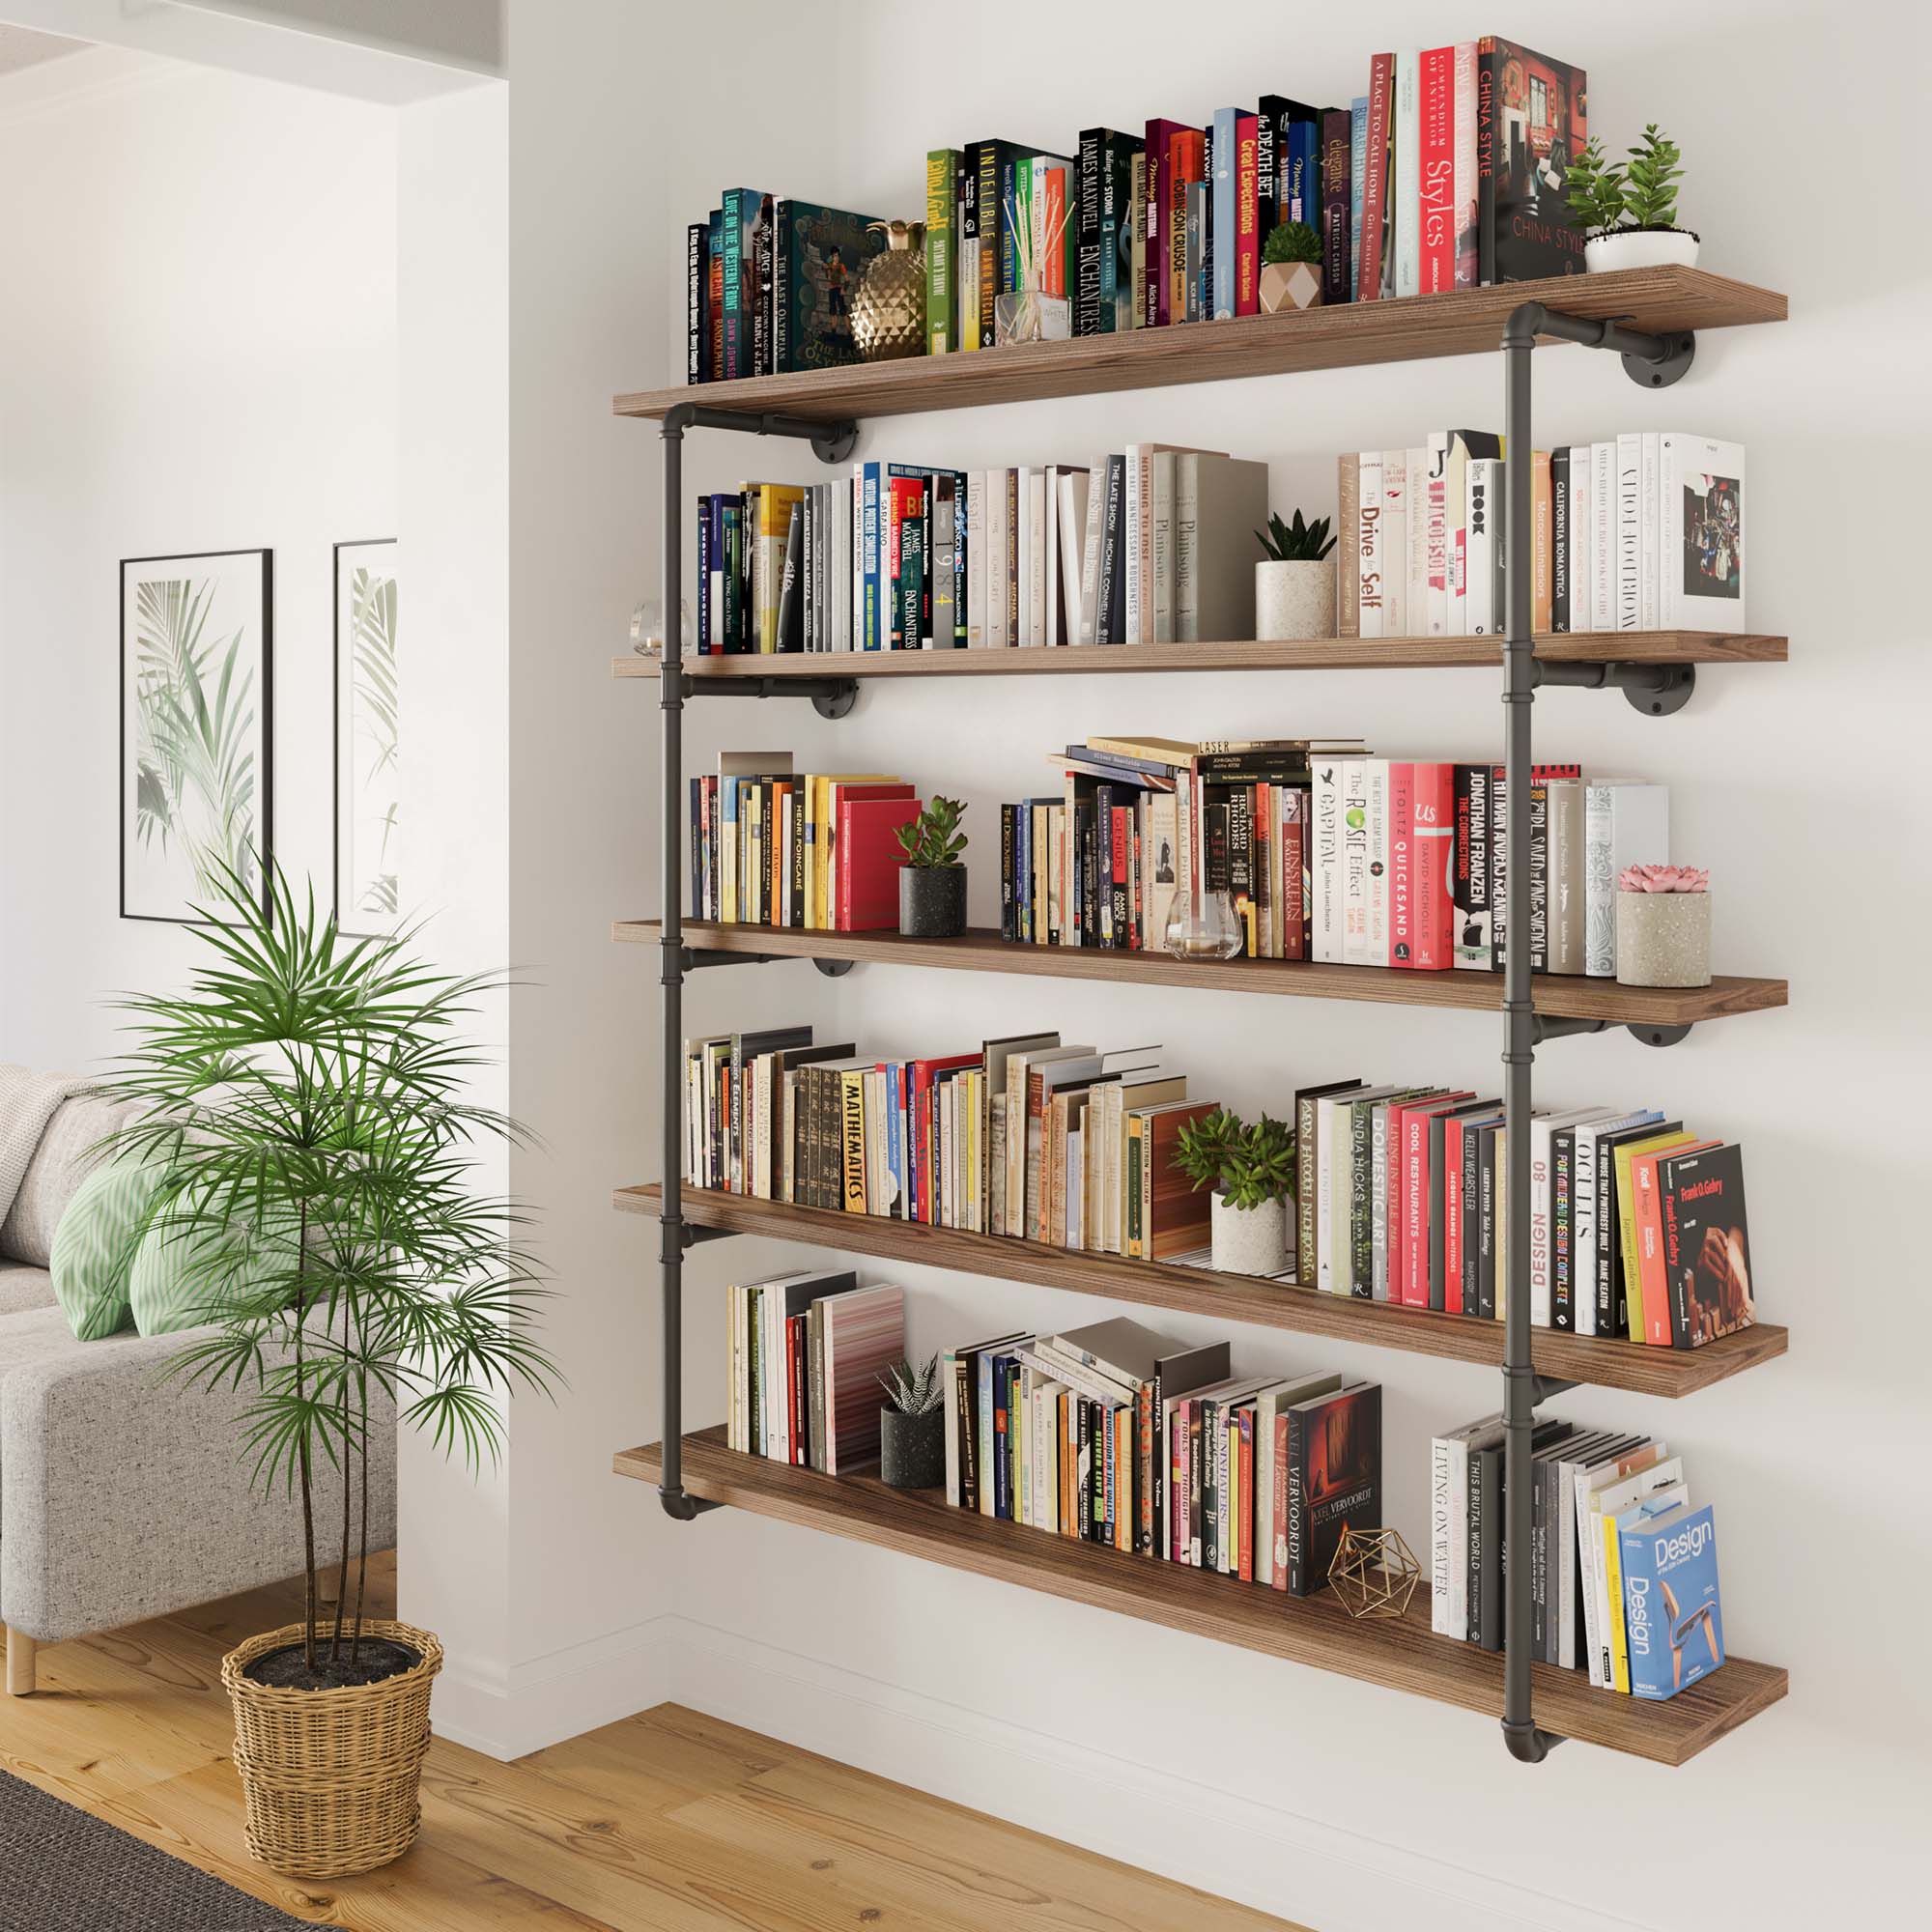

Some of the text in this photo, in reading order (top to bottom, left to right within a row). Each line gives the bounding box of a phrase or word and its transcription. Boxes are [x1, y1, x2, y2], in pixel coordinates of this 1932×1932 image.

[1373, 73, 1383, 110] PLACE
[1370, 135, 1380, 164] CALL
[1372, 116, 1381, 131] TO
[1478, 71, 1492, 178] CHINA STYLE
[1080, 138, 1097, 173] JAMES
[1103, 150, 1113, 214] Riding the STORM
[1258, 115, 1272, 198] the DEATH BET
[1321, 139, 1349, 192] elegance
[927, 196, 950, 232] Harry
[980, 147, 995, 240] INDELIBLE
[1080, 176, 1097, 232] MAXWELL
[1174, 179, 1185, 231] ROBINSON
[1240, 140, 1255, 235] Great Expectations
[1368, 169, 1378, 206] HOME
[1420, 160, 1453, 247] Styles
[725, 193, 739, 309] LOVE ON THE WESTERN FRONT
[1174, 234, 1185, 272] CRUSOE
[981, 250, 993, 326] DAWN METCALF
[1148, 284, 1157, 325] Alicia Airey
[866, 478, 876, 506] VIRTUAL
[1109, 482, 1118, 502] LATE
[1429, 449, 1446, 478] J
[866, 507, 876, 533] PATIENT
[1141, 513, 1149, 528] TO
[1473, 485, 1484, 535] BOOK
[866, 535, 876, 574] SIMULATION
[902, 522, 911, 561] MAXWELL
[1103, 538, 1113, 576] MICHAEL
[1155, 519, 1169, 587] Plainsong
[1177, 520, 1196, 588] Plainsong
[905, 590, 917, 648] ENCHANTRESS
[1099, 578, 1110, 622] CONNELLY
[1199, 741, 1230, 753] LASER
[1321, 794, 1335, 867] CAPITAL
[1397, 788, 1406, 835] TOLTZ
[1459, 797, 1468, 880] THE CORRECTIONS
[1470, 772, 1485, 904] JONATHAN FRANZEN
[1115, 816, 1123, 867] GENIUS
[1290, 838, 1300, 922] EINSTEIN
[1395, 841, 1406, 936] QUICKSAND
[846, 1085, 863, 1200] MATHEMATICS
[1354, 1115, 1364, 1202] INDIA HICKS
[1389, 1123, 1399, 1219] LIVING IN STYLE
[1373, 1118, 1384, 1250] DOMESTIC ART
[1409, 1123, 1419, 1237] COOL RESTAURANTS
[1464, 1134, 1475, 1210] KELLY WEARSTLER
[1576, 1144, 1592, 1237] OCULUS
[1532, 1161, 1547, 1287] DESIGN 80
[1557, 1154, 1569, 1304] POSTMODERN DESIGN COMPLETE
[1665, 1196, 1676, 1221] Frank
[1668, 1236, 1679, 1266] Gehry
[1106, 1463, 1113, 1471] IN
[1290, 1466, 1299, 1563] VERVOORDT
[1435, 1445, 1447, 1596] LIVING ON WATER
[1471, 1461, 1480, 1570] THIS BRUTAL WORLD
[1655, 1520, 1712, 1568] Design
[1629, 1577, 1652, 1655] Design
